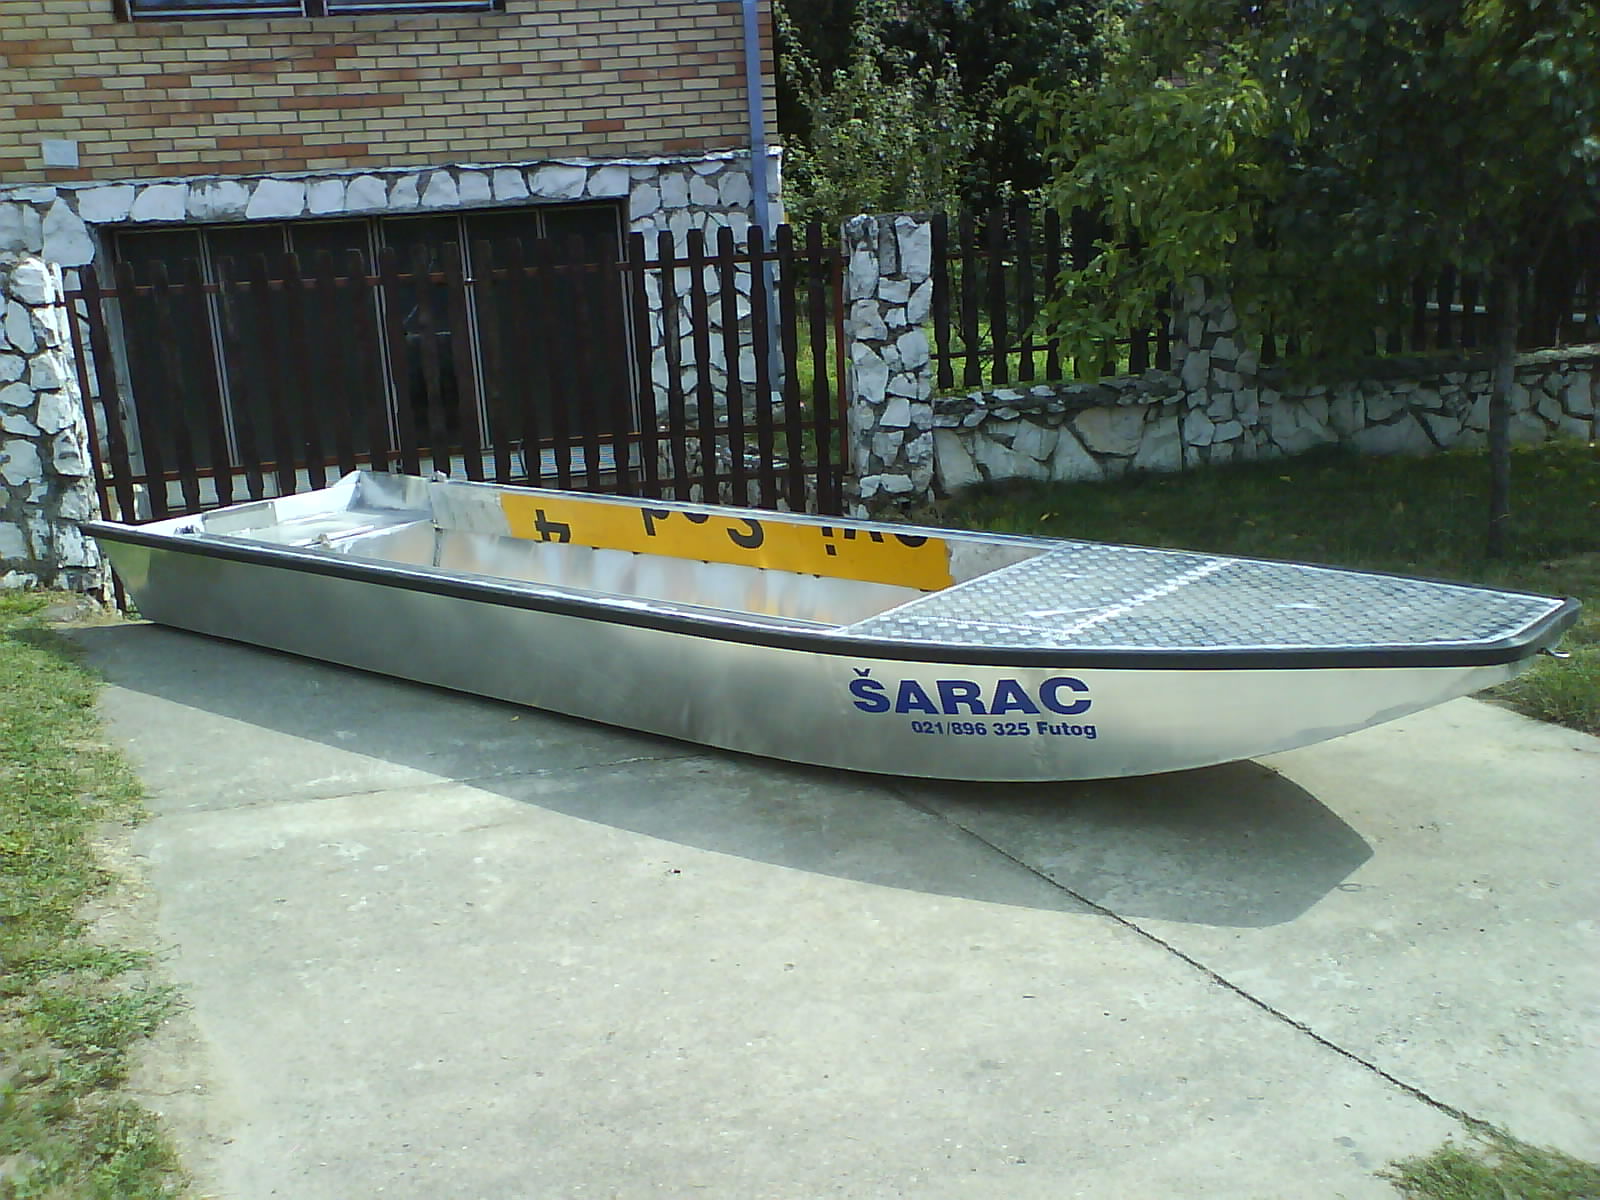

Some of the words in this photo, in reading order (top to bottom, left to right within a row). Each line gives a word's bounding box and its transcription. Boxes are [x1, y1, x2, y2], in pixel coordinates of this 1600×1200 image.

[849, 667, 1092, 715] ŠARAC
[911, 720, 987, 736] 021/896
[993, 722, 1030, 736] 325
[1036, 721, 1097, 739] Futog
